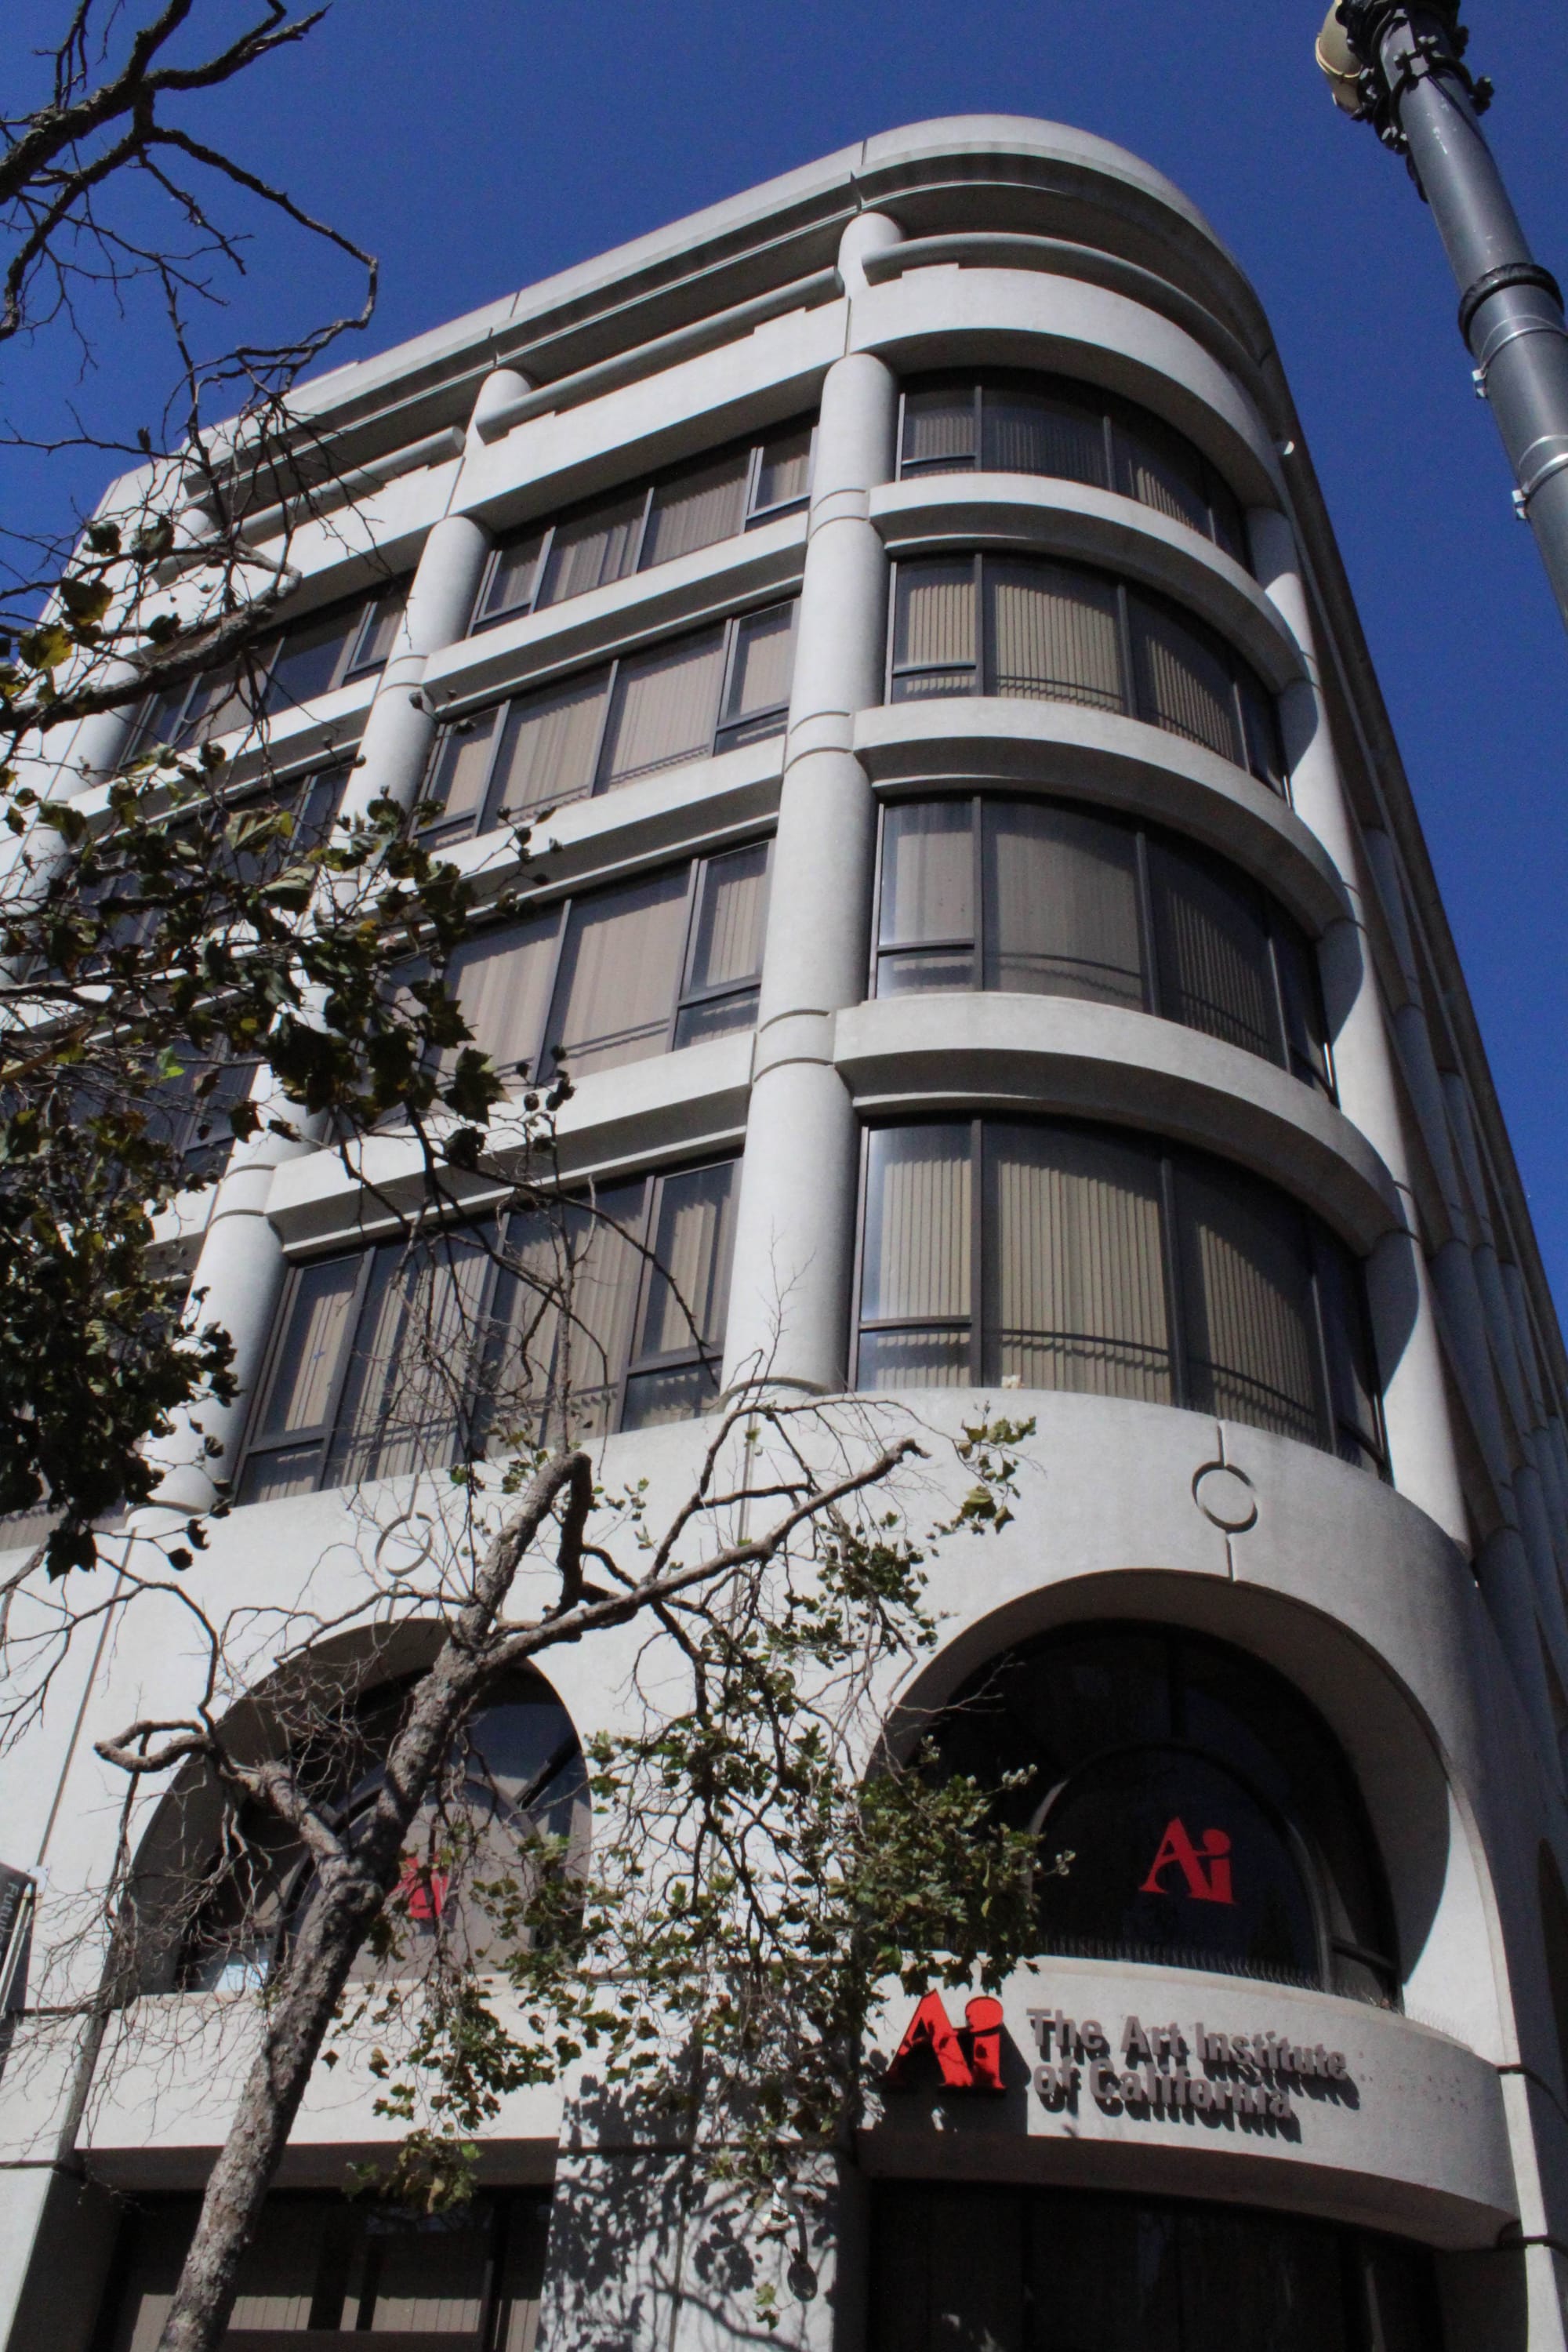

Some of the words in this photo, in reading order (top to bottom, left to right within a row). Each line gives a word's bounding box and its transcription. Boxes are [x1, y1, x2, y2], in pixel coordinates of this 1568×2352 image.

[1139, 1815, 1237, 1904] Ai
[878, 1989, 1007, 2089] Ai
[1026, 2008, 1102, 2049] The
[1121, 2016, 1181, 2056] Art
[1195, 2023, 1347, 2080] Institute
[1033, 2056, 1076, 2095] of
[1090, 2057, 1291, 2118] California
